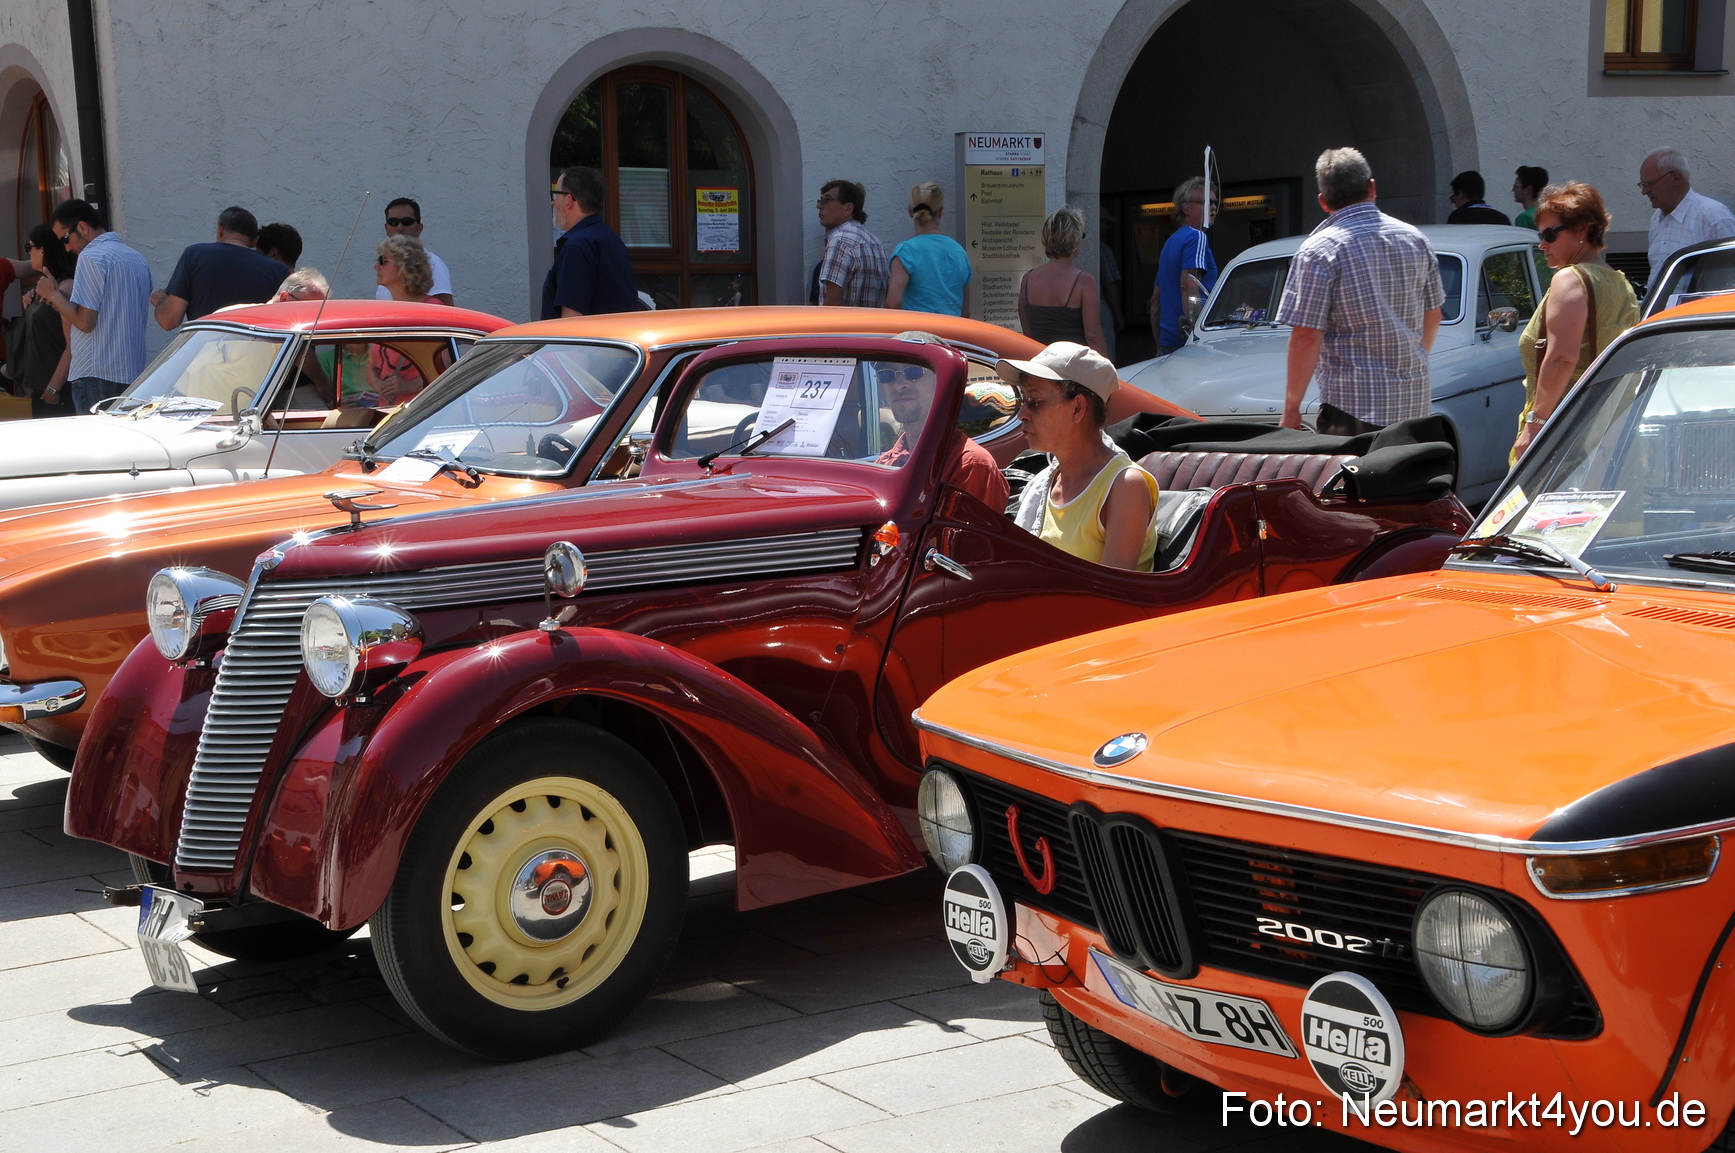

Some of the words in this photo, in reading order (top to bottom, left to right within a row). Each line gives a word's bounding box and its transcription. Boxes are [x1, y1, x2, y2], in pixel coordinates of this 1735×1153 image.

[968, 137, 1031, 148] NEUMARKT
[800, 380, 832, 399] 237
[978, 900, 992, 910] 500
[144, 896, 175, 938] RH
[948, 903, 994, 938] Hella
[1256, 917, 1375, 955] 2002
[968, 944, 989, 959] HELLA
[1110, 964, 1153, 1012] R
[1150, 986, 1222, 1038] HZ
[1216, 1002, 1288, 1051] 8H
[1363, 1016, 1384, 1029] 500
[1309, 1017, 1386, 1063] Hella
[1342, 1068, 1376, 1087] HELLA
